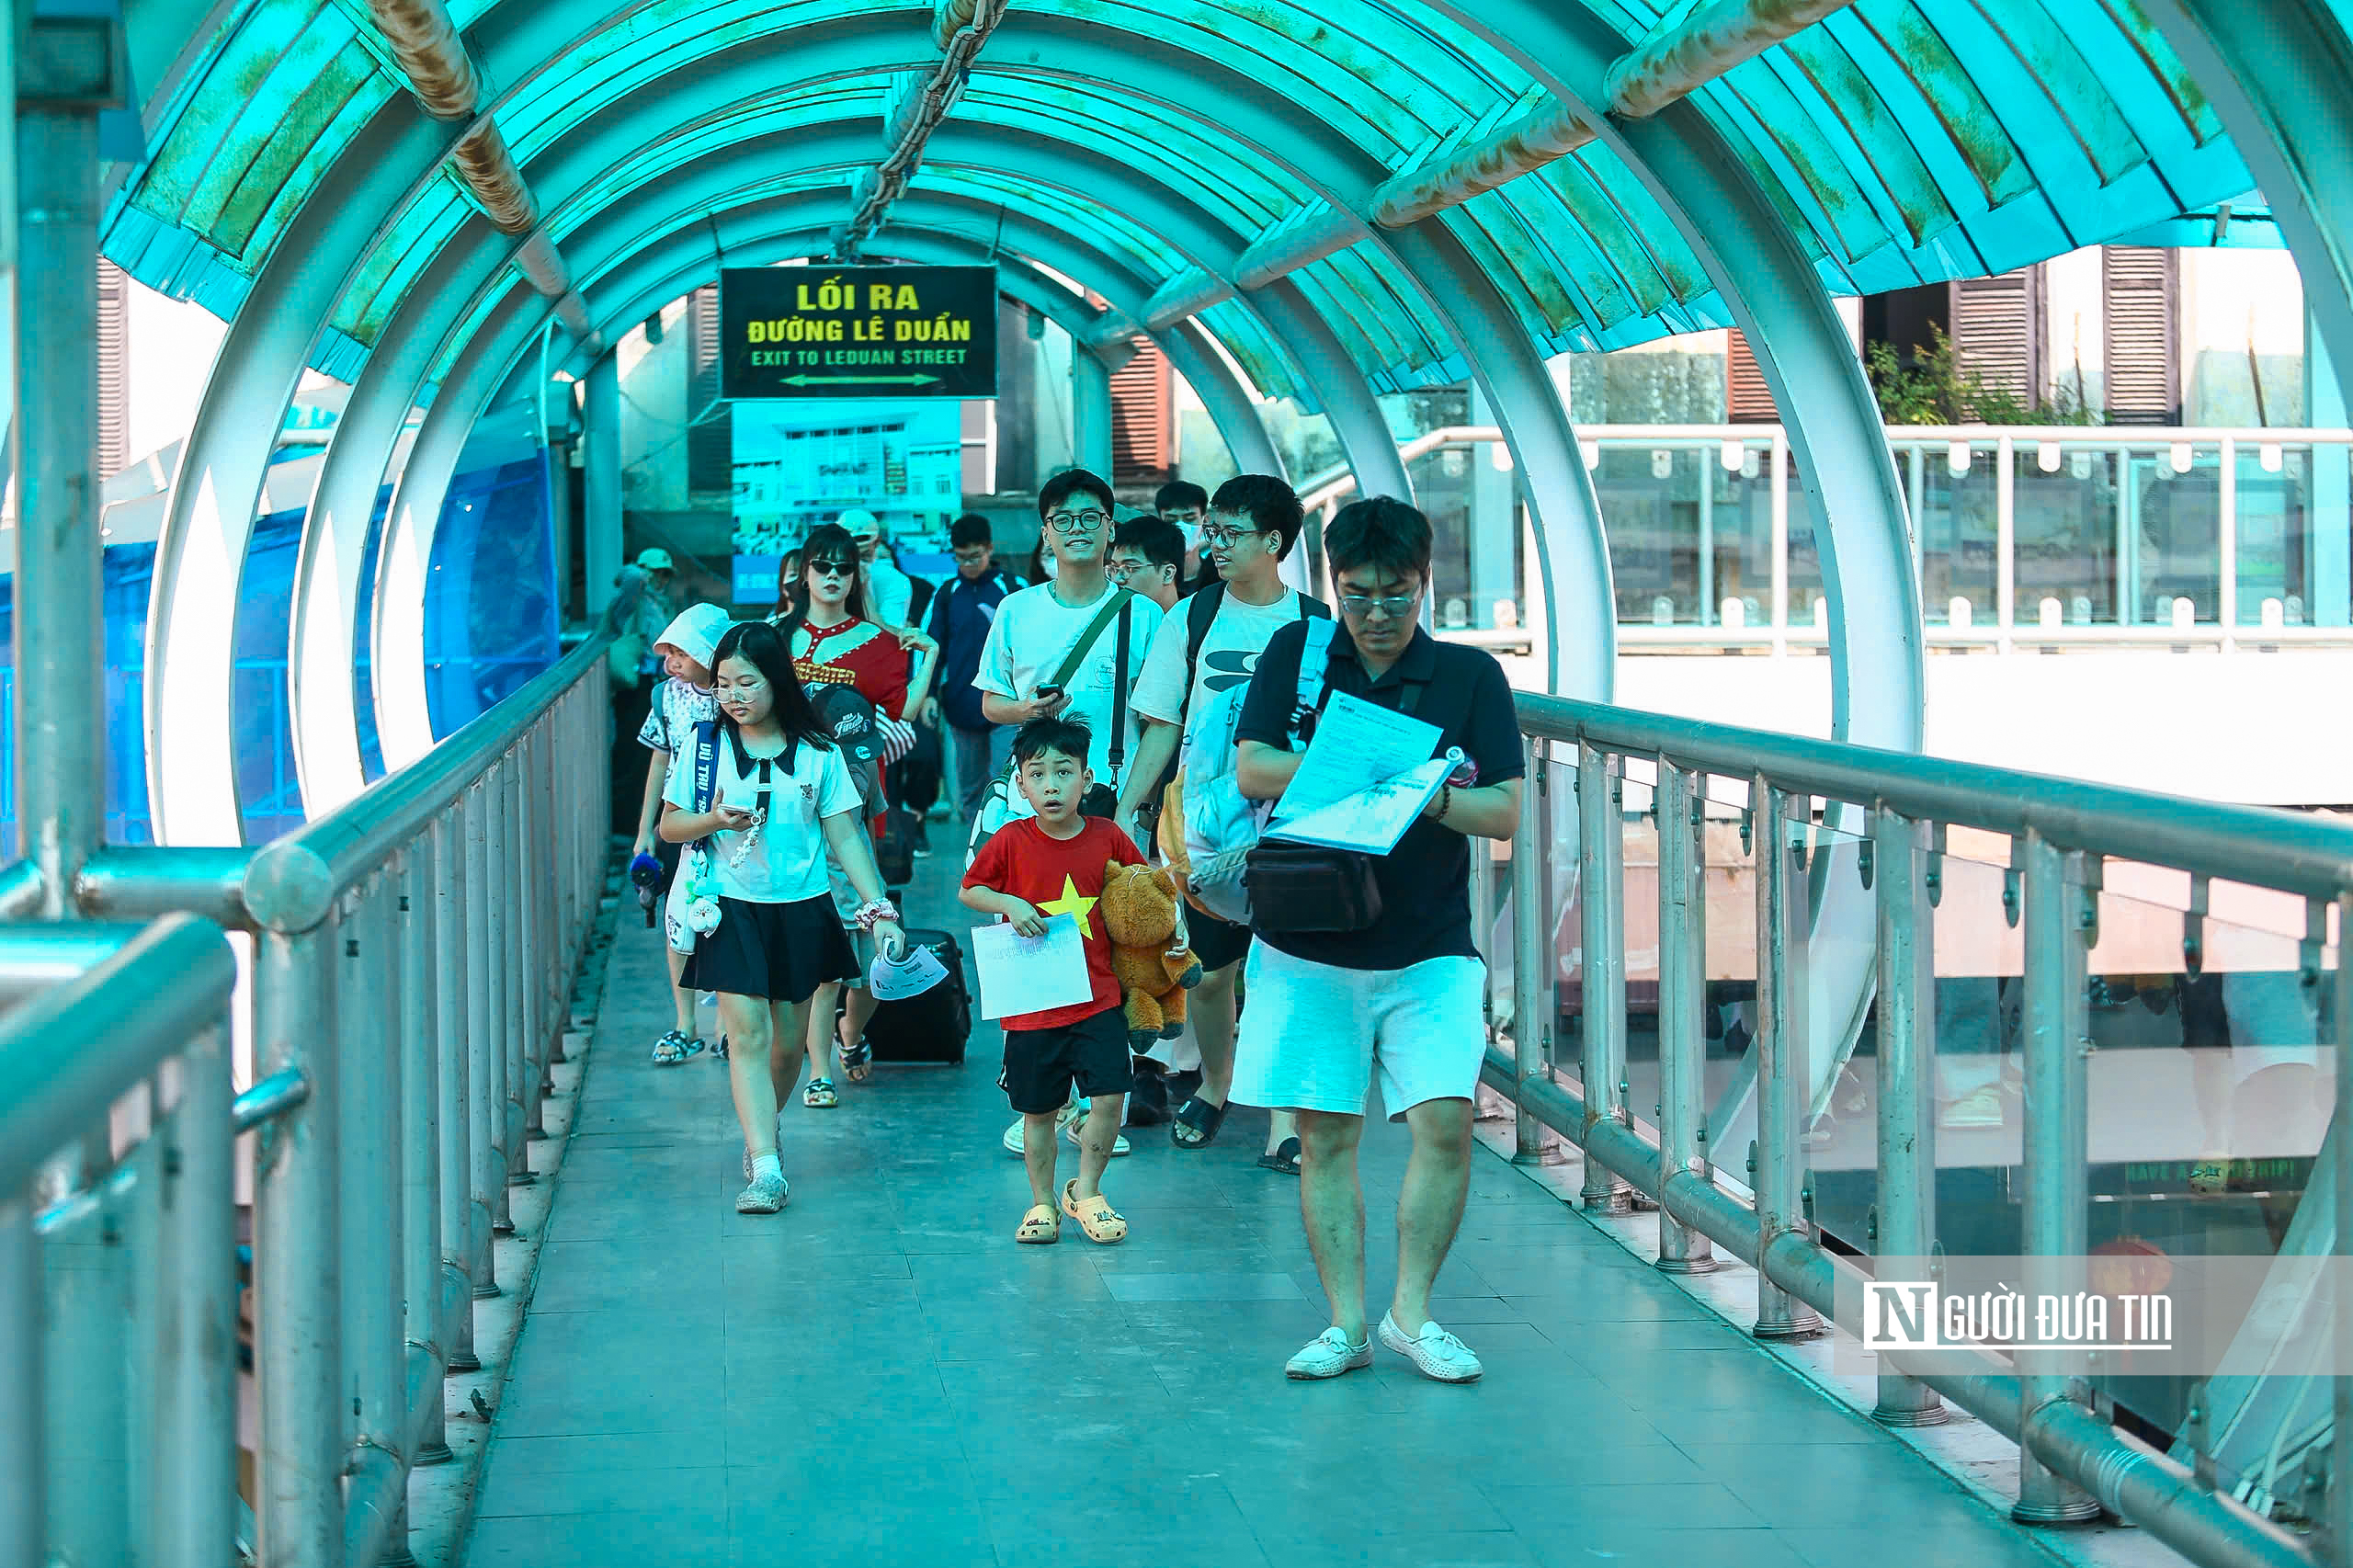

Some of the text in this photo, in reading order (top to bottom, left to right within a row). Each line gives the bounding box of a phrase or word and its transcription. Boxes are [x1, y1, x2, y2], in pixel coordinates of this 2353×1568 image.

[796, 274, 920, 311] LỐI RA
[747, 315, 844, 343] ĐƯỜNG
[852, 315, 884, 341] LÊ
[751, 348, 967, 366] EXIT TO LEDUAN STREET
